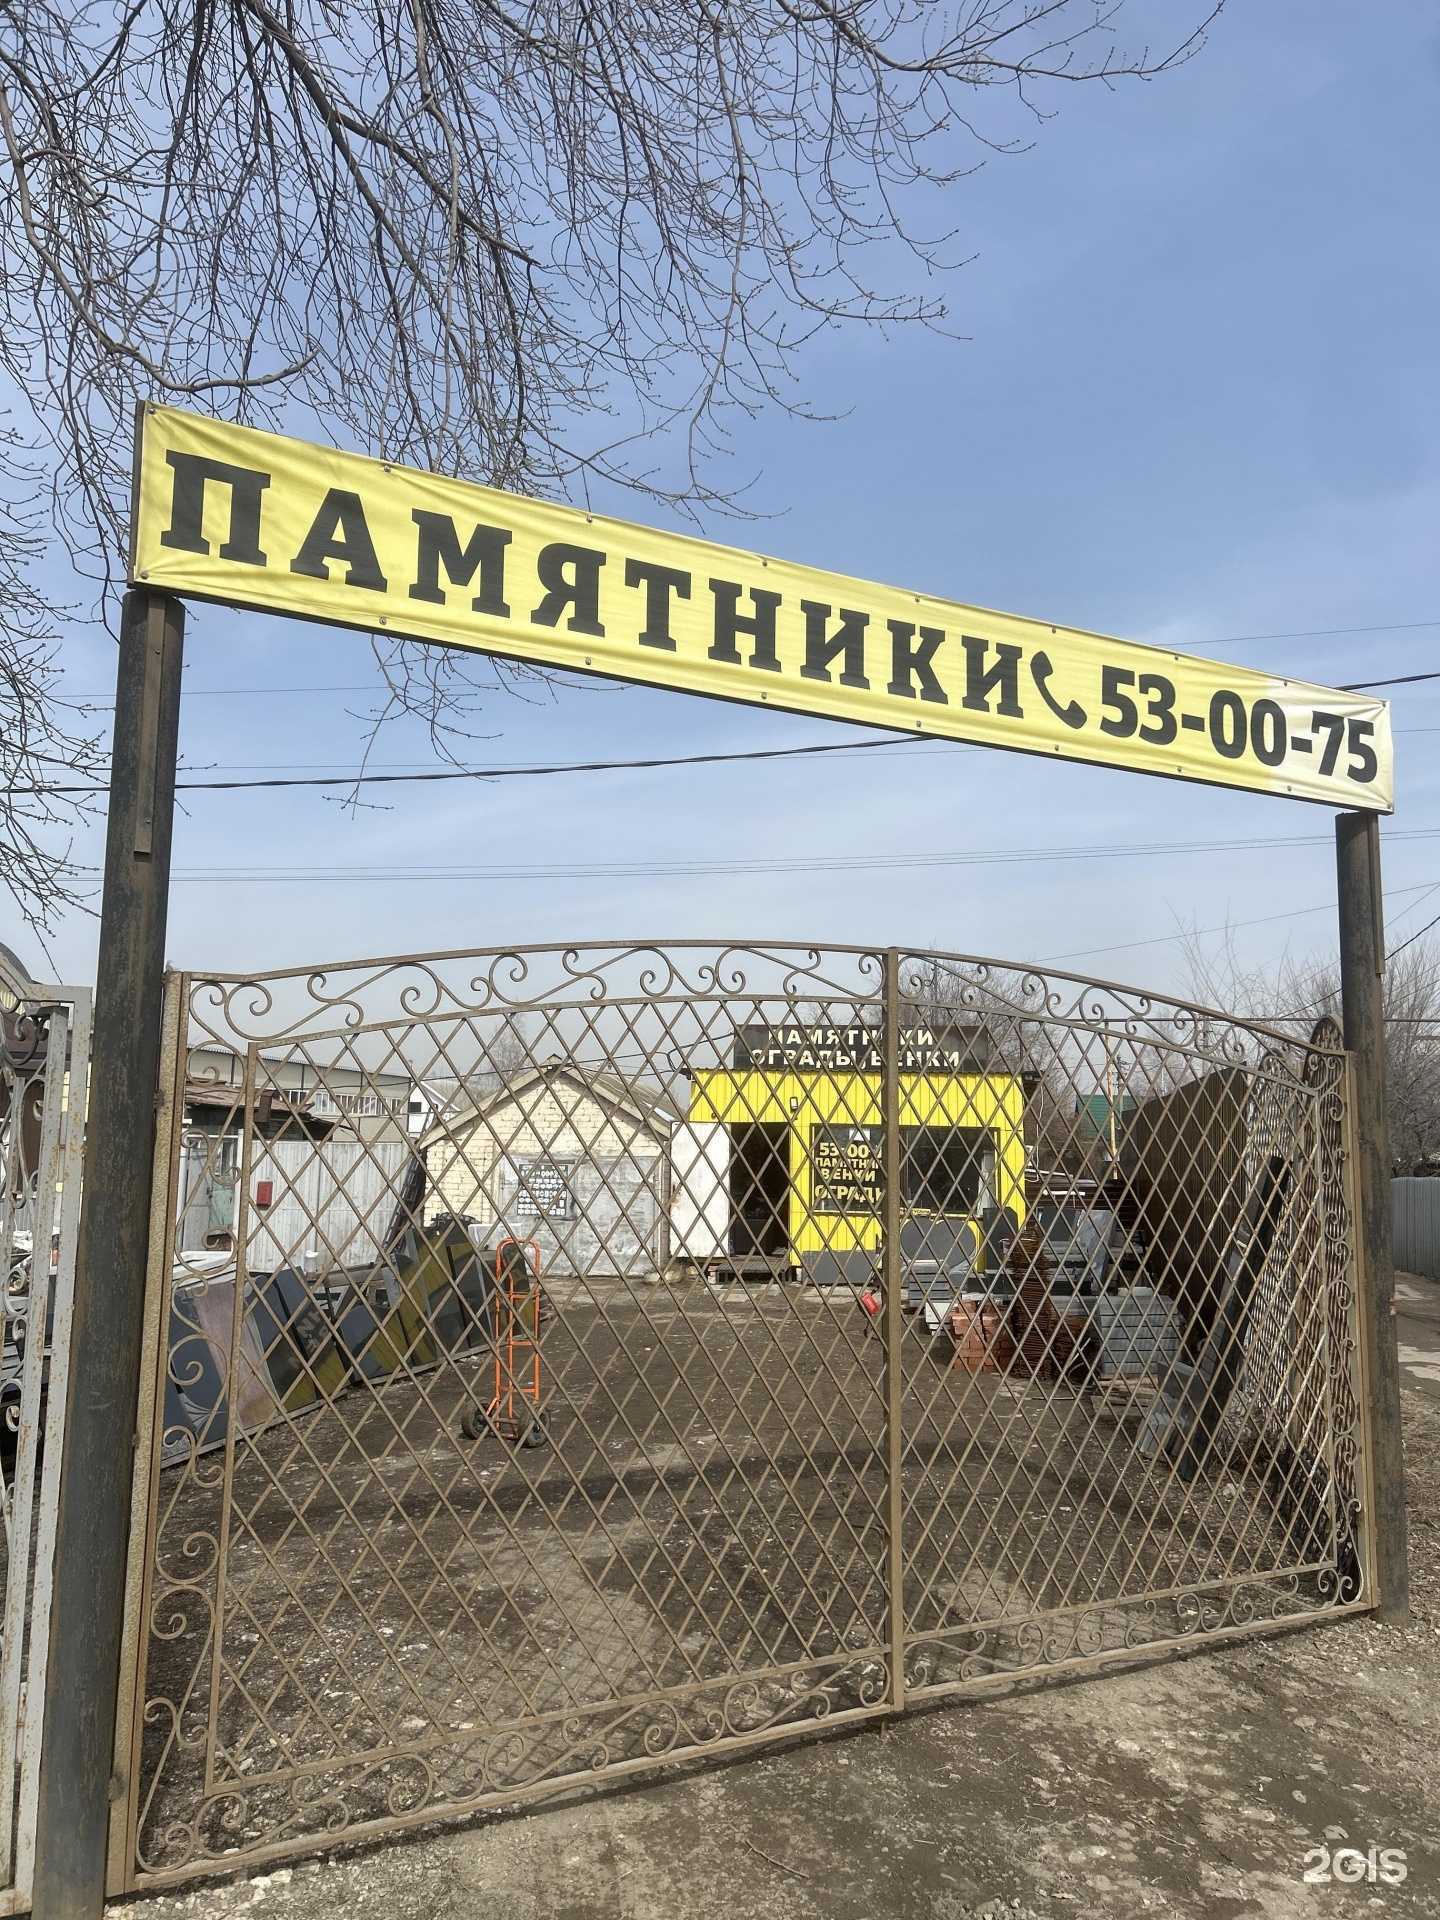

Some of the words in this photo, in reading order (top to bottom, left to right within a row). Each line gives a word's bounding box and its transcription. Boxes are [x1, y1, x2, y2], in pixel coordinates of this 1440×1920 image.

[161, 449, 1024, 719] ПАМЯТНИКИ
[1100, 664, 1378, 783] 53-00-75
[768, 1028, 933, 1046] ПАМЯТНКИ
